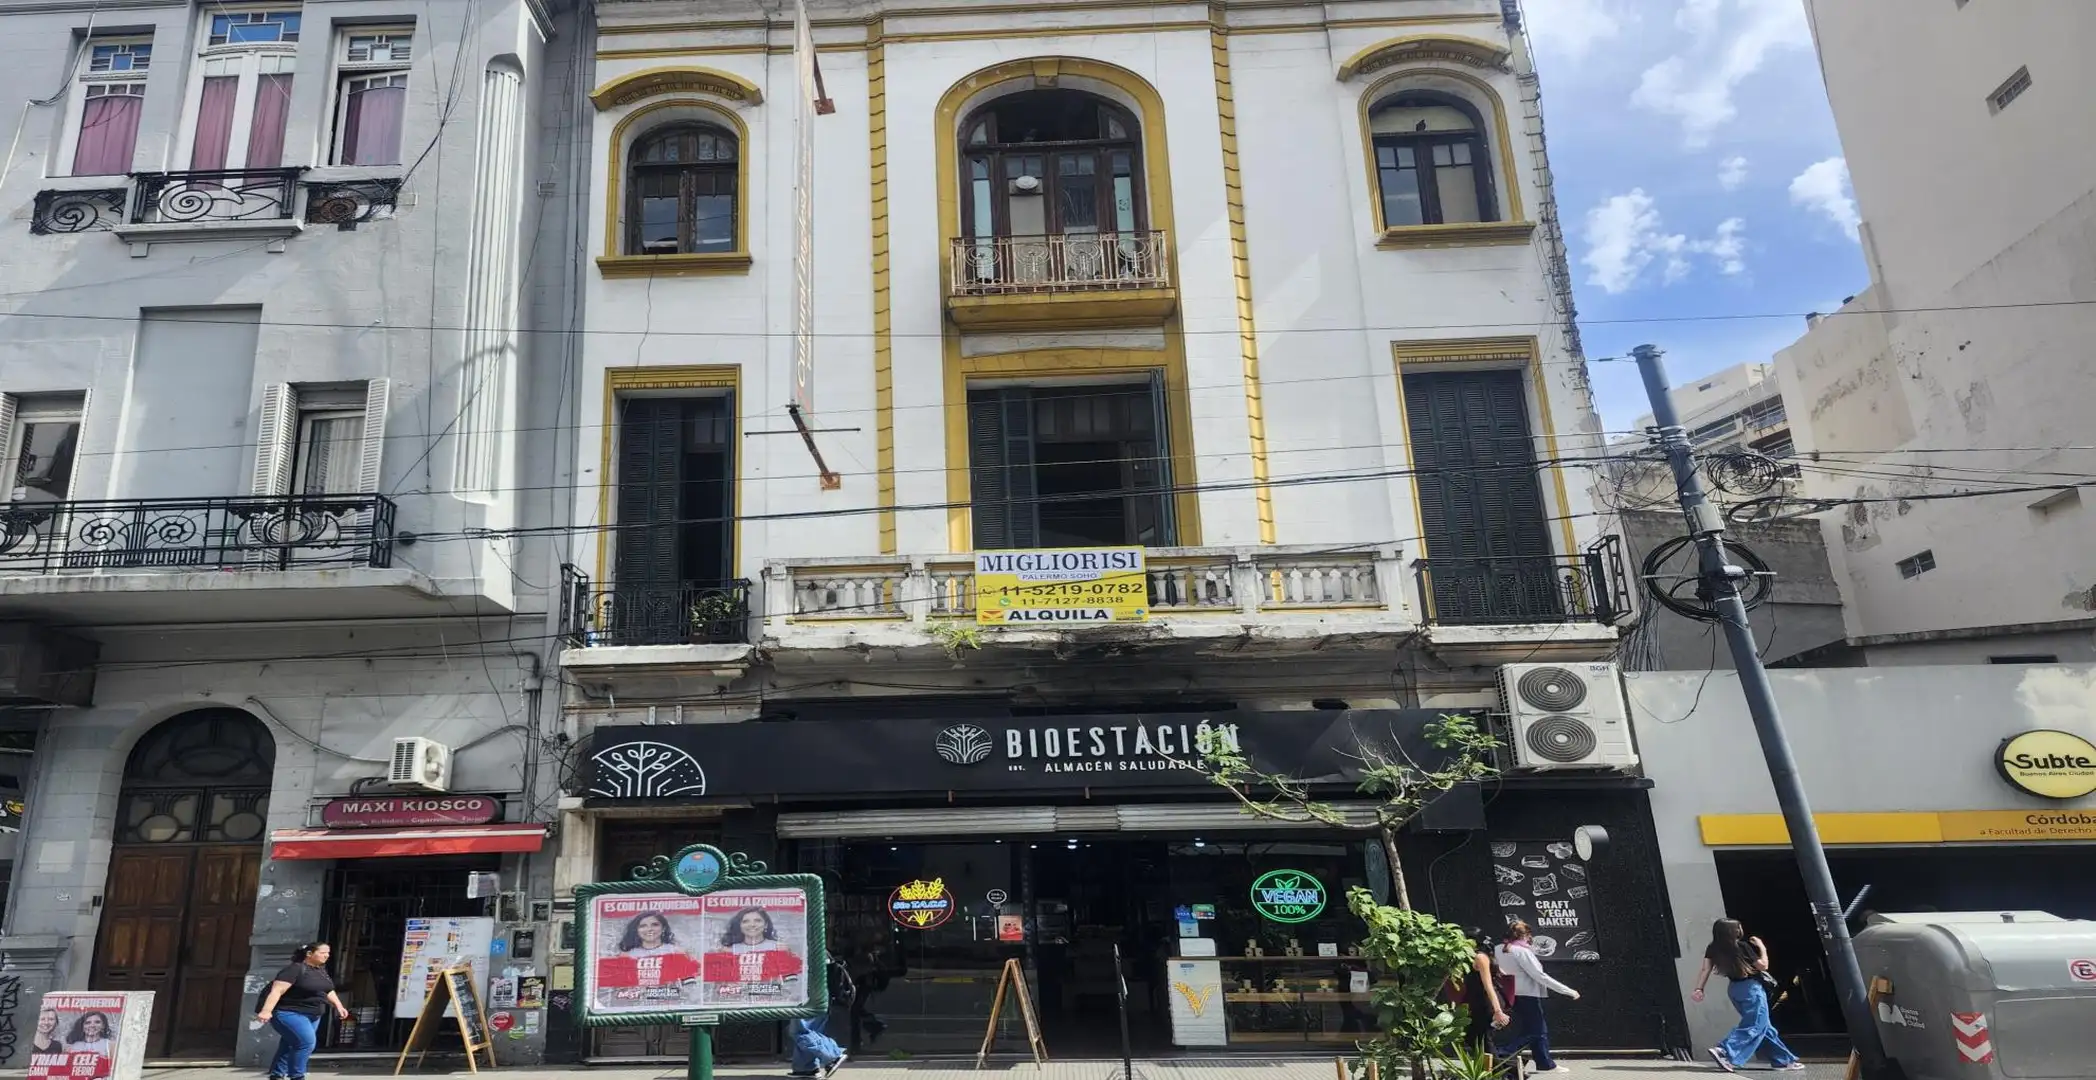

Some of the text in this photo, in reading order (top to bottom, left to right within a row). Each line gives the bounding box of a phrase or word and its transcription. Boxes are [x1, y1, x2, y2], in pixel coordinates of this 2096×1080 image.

[981, 552, 1137, 572] MIGLIORISI
[1000, 583, 1143, 596] 11-5219-0782
[1021, 596, 1124, 605] 11-7127-8838
[1008, 609, 1109, 621] ALQUILA
[1006, 720, 1239, 758] BIOESTACIÓN
[1044, 760, 1113, 773] ALMACÉN
[1119, 758, 1205, 771] SALUDABLE
[2014, 753, 2092, 770] Subte
[342, 799, 482, 813] MAXI KIOSCO
[2049, 826, 2092, 834] Derecho
[707, 897, 719, 907] ES
[739, 897, 752, 906] LA
[1261, 888, 1318, 904] VEGAN
[604, 902, 616, 912] ES
[636, 901, 648, 911] LA
[649, 899, 699, 912] IZQUIERDA
[1273, 904, 1306, 915] 100%
[1535, 900, 1569, 909] CRAFT
[1538, 909, 1576, 918] VEGAN
[1538, 917, 1579, 926] BAKERY
[637, 957, 663, 969] CELE
[739, 953, 765, 964] CELE
[57, 997, 69, 1009] LA
[73, 1053, 99, 1066] CELE
[72, 1066, 95, 1077] FIERRO
